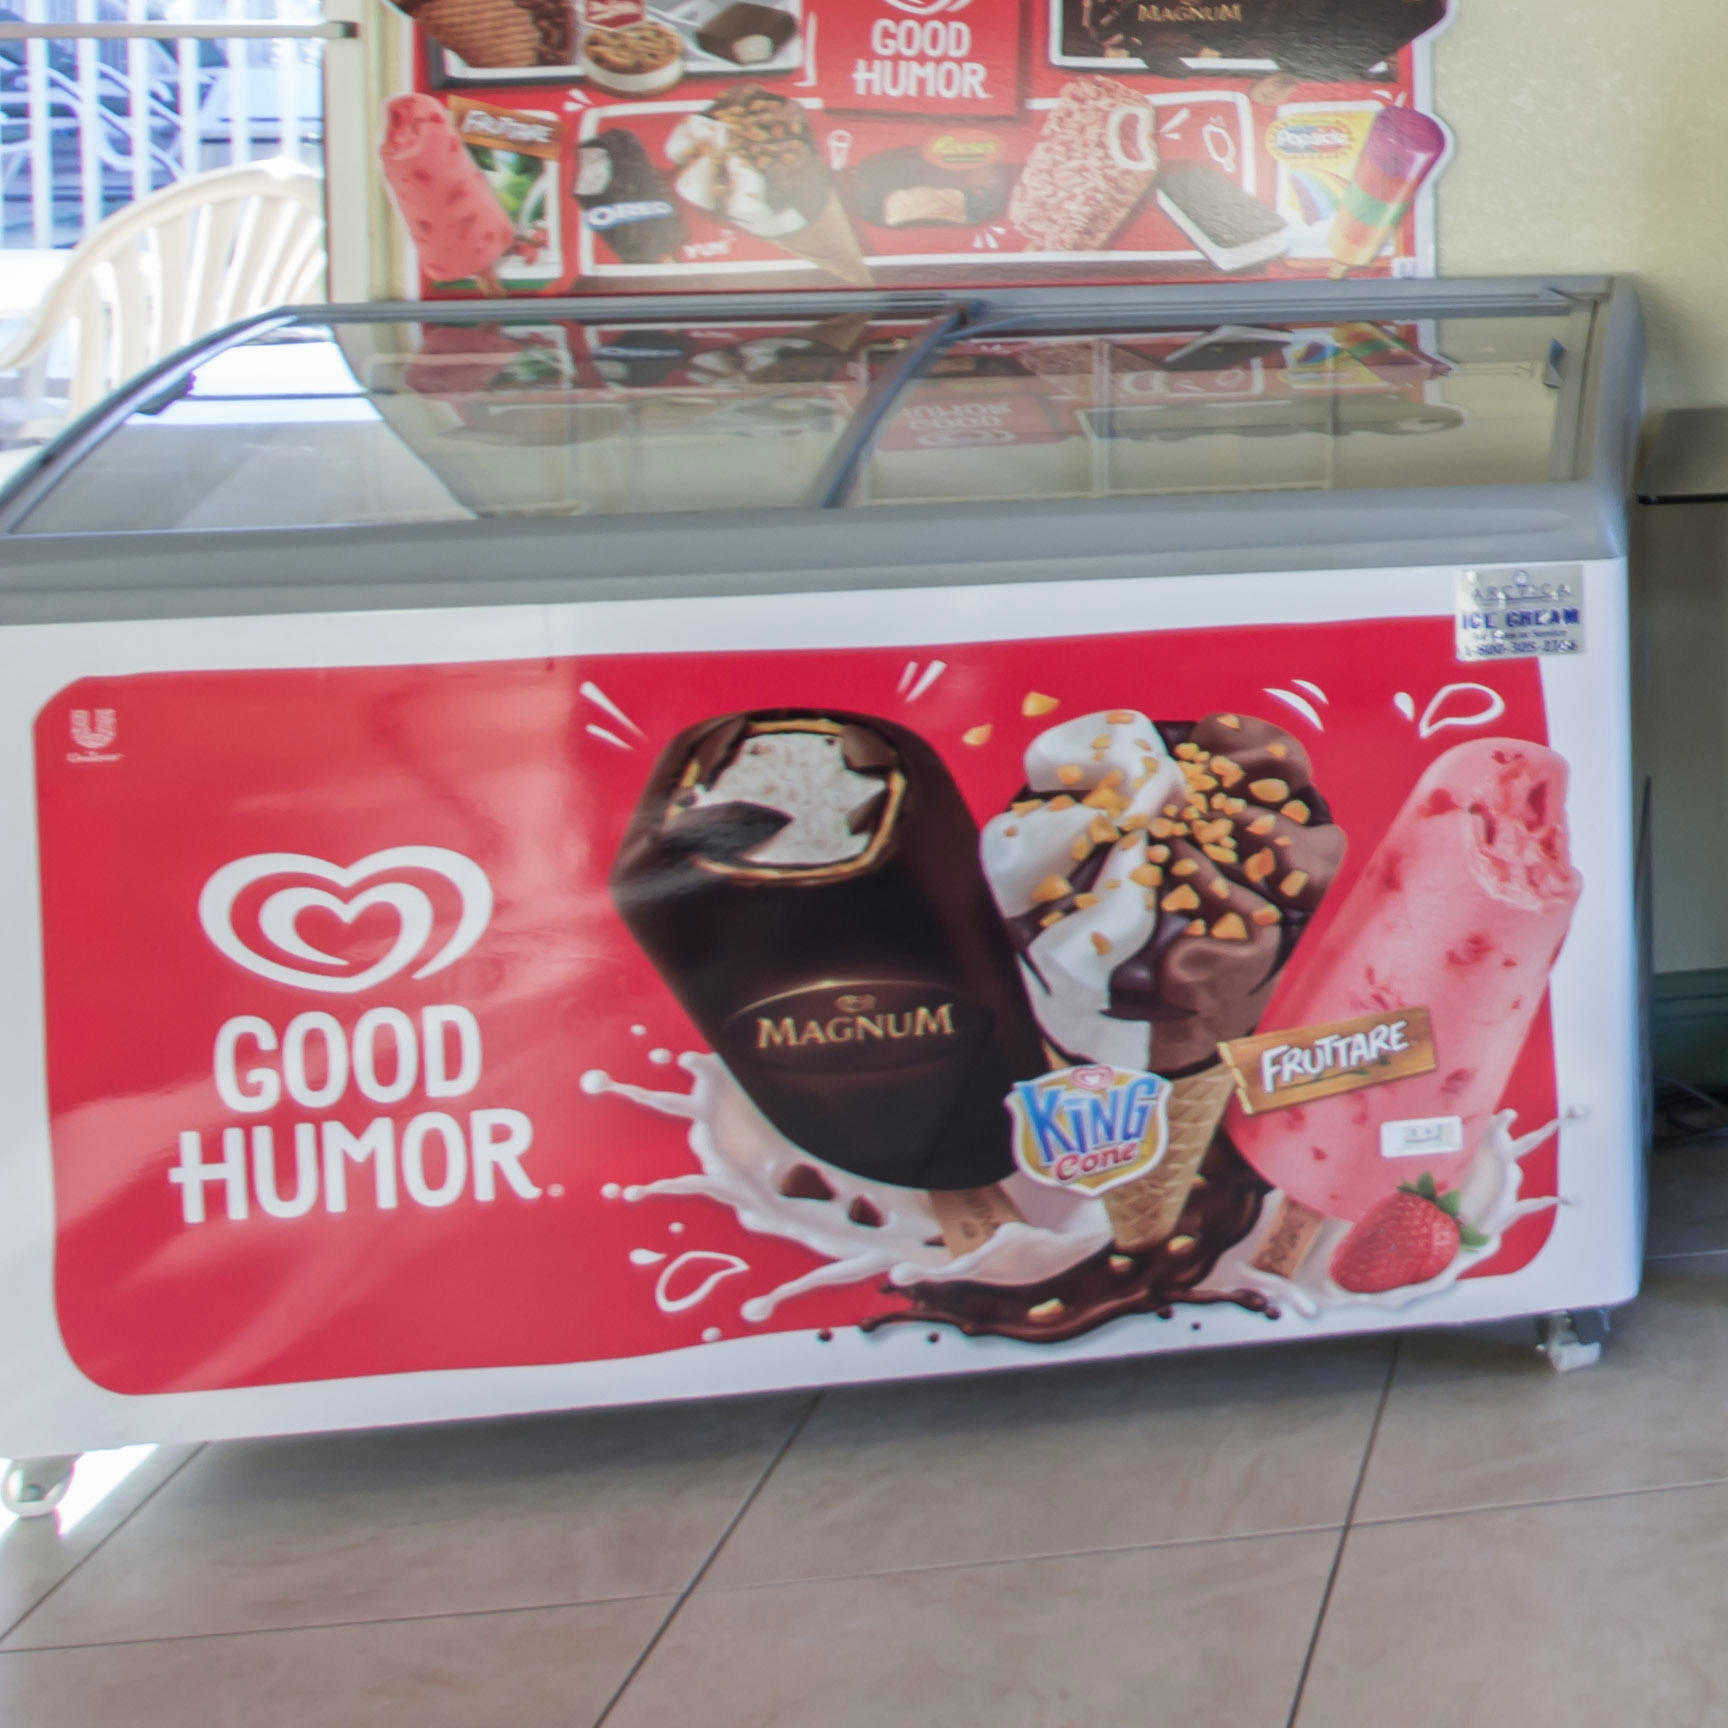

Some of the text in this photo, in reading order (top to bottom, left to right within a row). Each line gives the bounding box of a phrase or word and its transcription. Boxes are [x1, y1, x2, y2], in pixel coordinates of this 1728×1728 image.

[1137, 3, 1242, 23] MAGNUM
[871, 18, 972, 58] GOOD
[853, 58, 994, 100] HUMOR
[757, 1003, 954, 1049] MAGNUM
[213, 1005, 482, 1112] GOOD
[1262, 1020, 1410, 1094] FRUTTARE
[1019, 1077, 1158, 1164] KING
[169, 1108, 541, 1223] HUMOR
[1056, 1142, 1137, 1181] Cone
